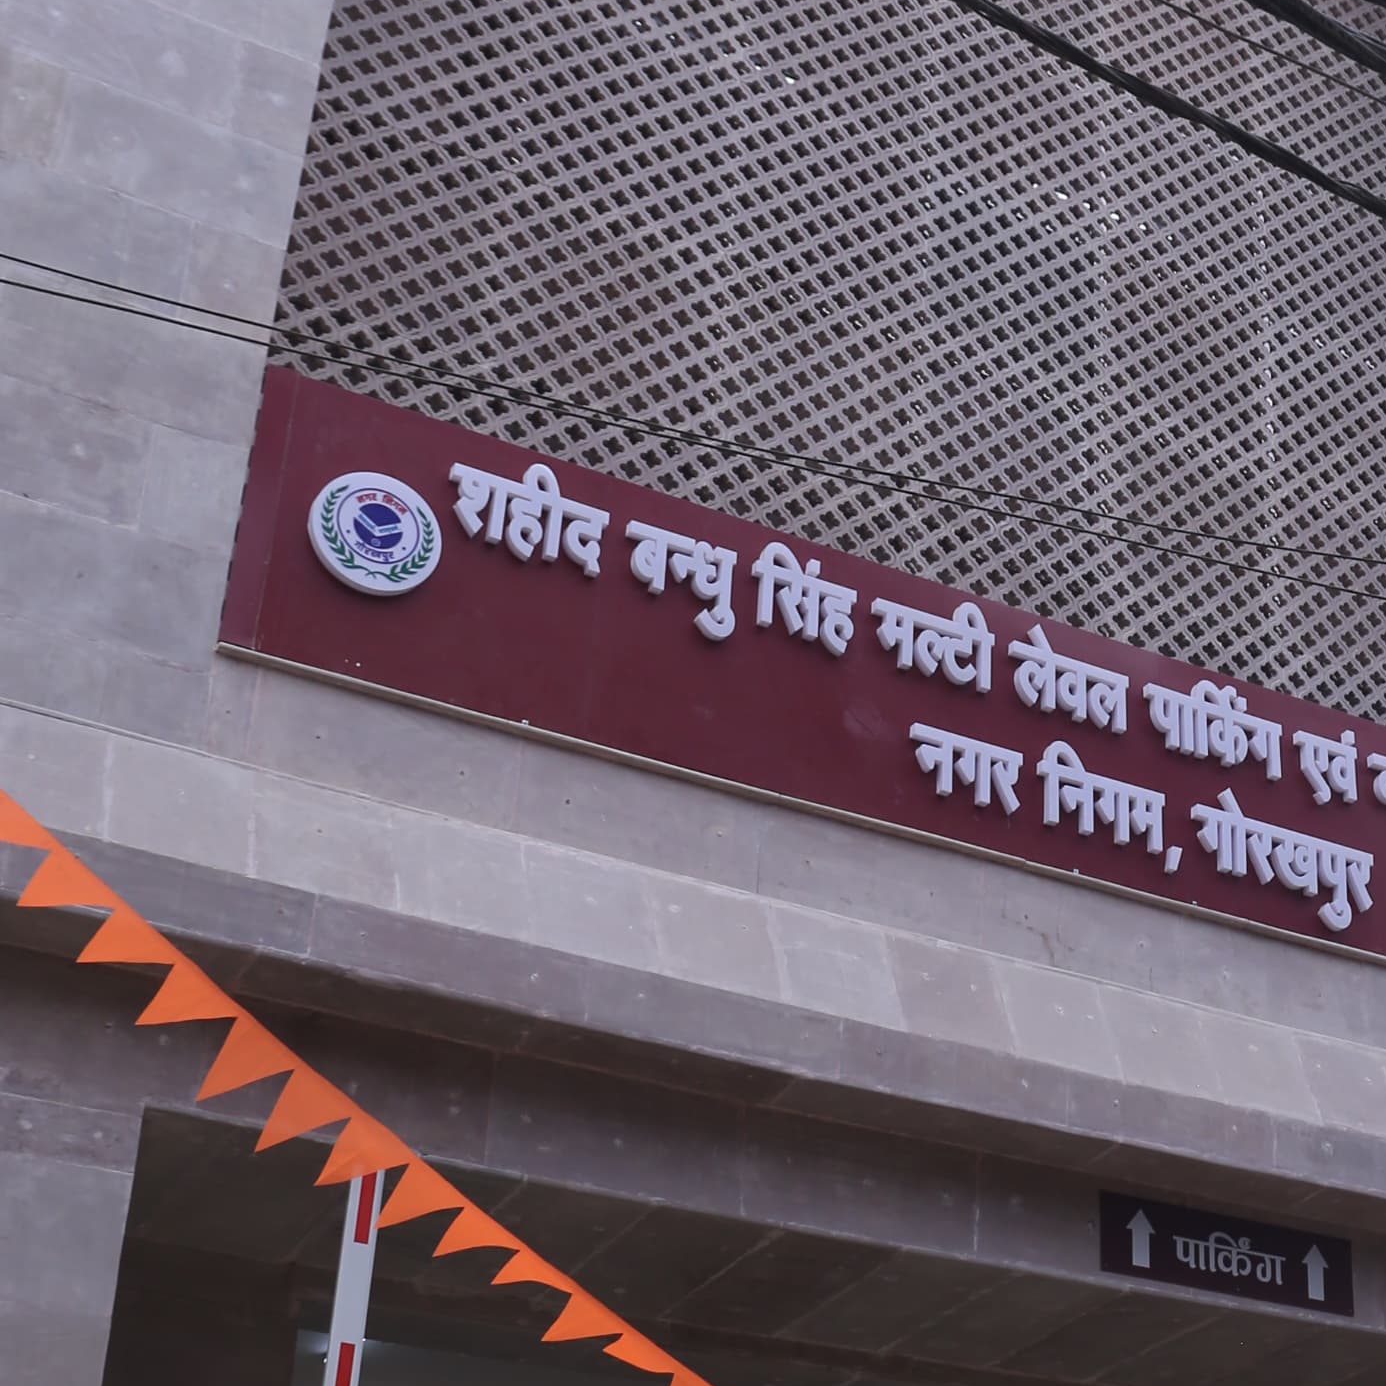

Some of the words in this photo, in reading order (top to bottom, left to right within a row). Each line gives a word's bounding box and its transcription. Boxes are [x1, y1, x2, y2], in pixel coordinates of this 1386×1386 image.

[449, 462, 610, 578] शहीद
[625, 519, 738, 642] बन्धु
[751, 541, 858, 657] सिंह
[871, 601, 996, 694] मल्टी
[1008, 623, 1130, 734] लेवल
[1142, 679, 1282, 782] पार्किंग
[1292, 729, 1358, 806] एवं
[909, 722, 1024, 815] नगर
[1036, 740, 1183, 875] निगम,
[1190, 787, 1374, 932] गोरखपुर
